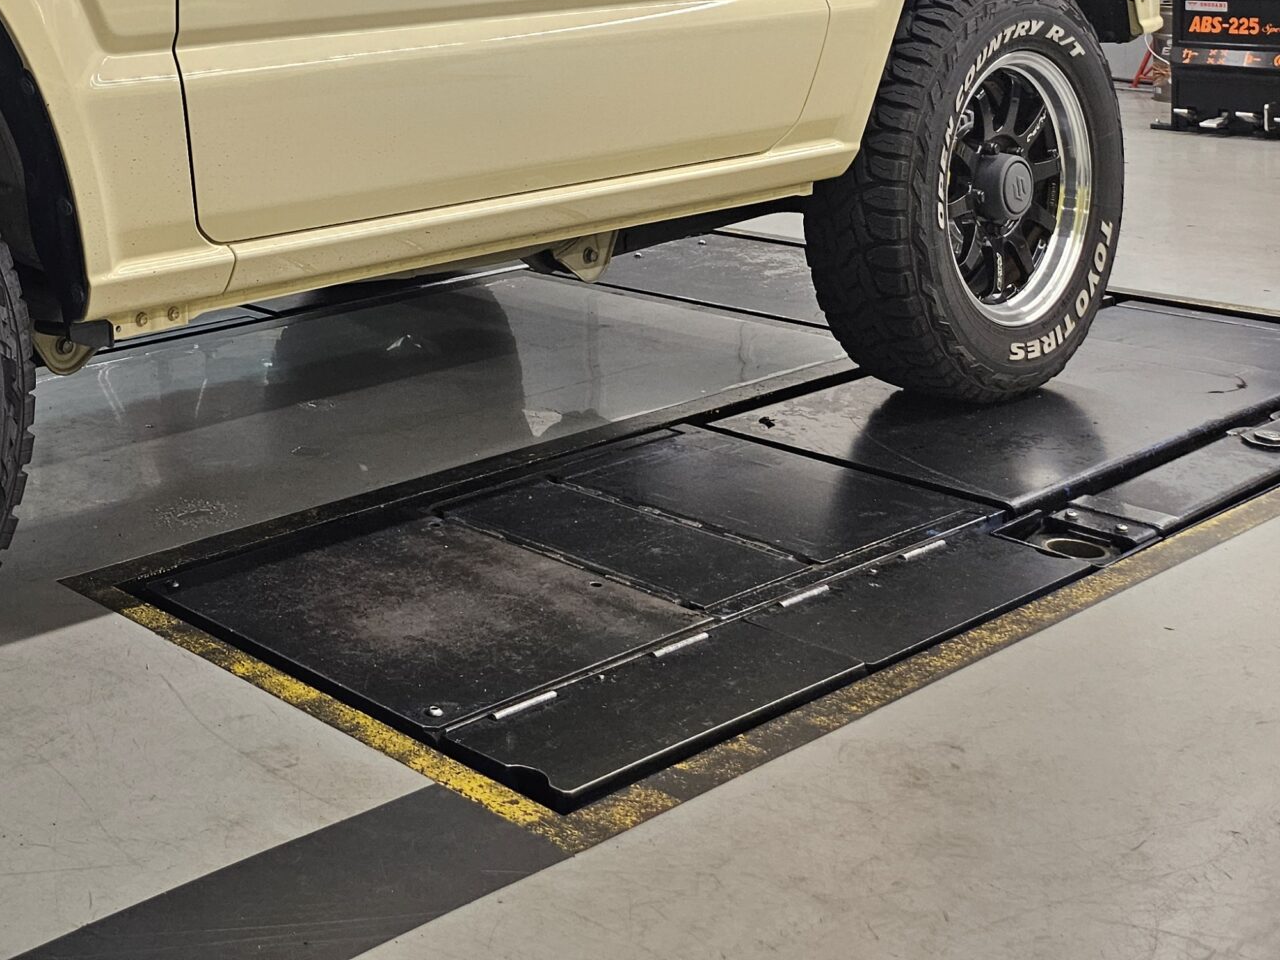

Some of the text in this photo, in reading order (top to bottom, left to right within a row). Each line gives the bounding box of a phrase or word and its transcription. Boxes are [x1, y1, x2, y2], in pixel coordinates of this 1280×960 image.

[1189, 16, 1260, 35] ABS-225
[938, 115, 954, 230] OPEN
[955, 19, 1045, 112] COUNTRY
[1045, 24, 1085, 57] R/T
[1009, 221, 1113, 361] TOYO TIRES
